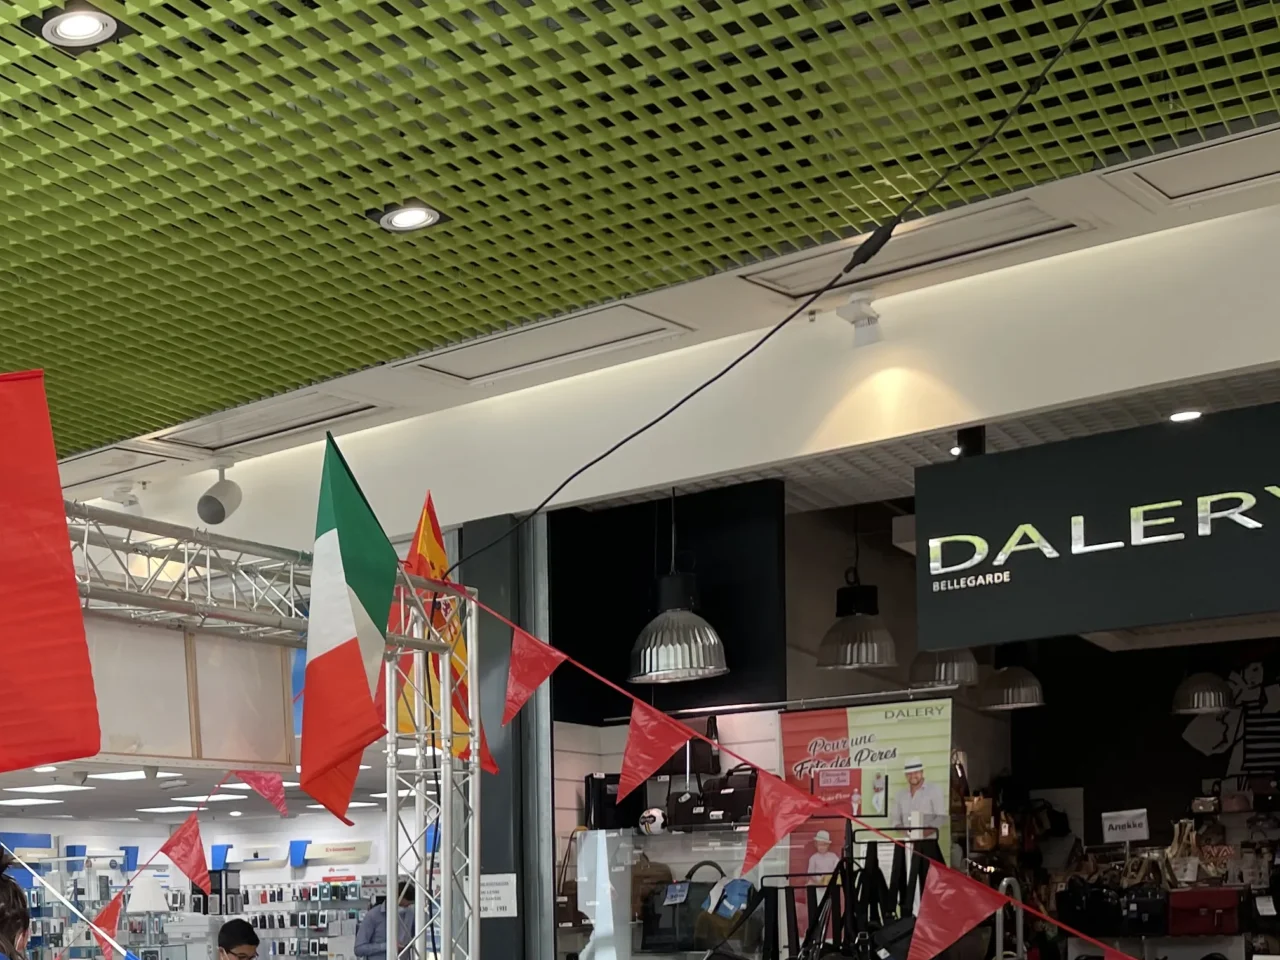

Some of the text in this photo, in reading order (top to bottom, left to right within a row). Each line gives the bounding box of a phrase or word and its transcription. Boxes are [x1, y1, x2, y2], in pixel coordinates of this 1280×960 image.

[932, 571, 1011, 592] BELLEGARDE
[884, 706, 945, 720] DALERY
[808, 733, 876, 756] Pour une
[854, 747, 897, 766] Pères
[1108, 821, 1144, 832] Anekke
